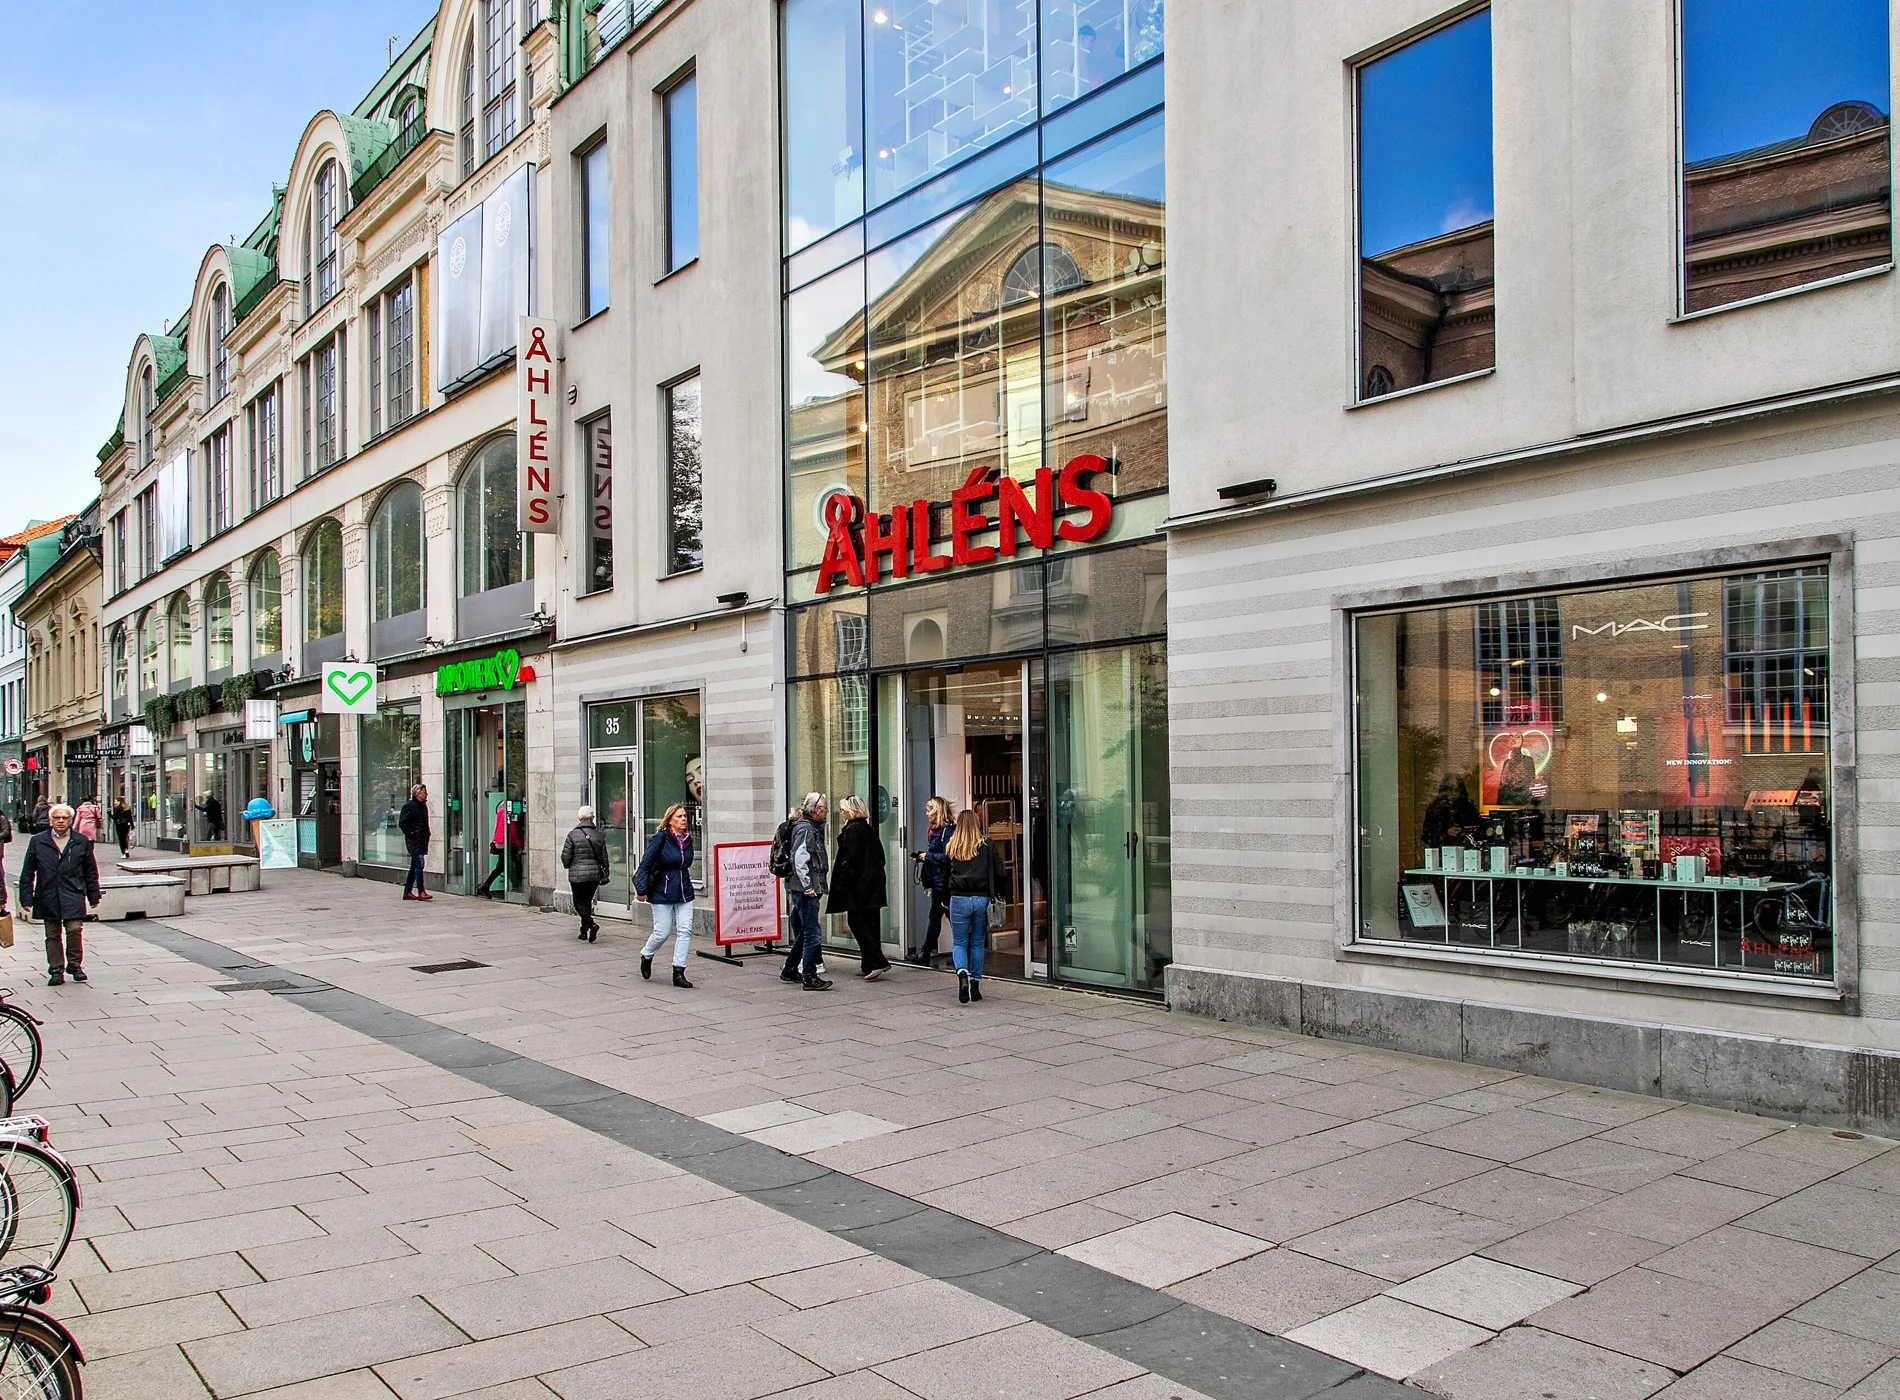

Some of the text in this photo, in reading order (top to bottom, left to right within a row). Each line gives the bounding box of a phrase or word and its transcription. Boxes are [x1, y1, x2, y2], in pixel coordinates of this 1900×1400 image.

[525, 326, 552, 524] ÅHLÉNS
[815, 454, 1112, 594] ÅHLÉNS
[436, 657, 500, 695] APOTEK
[605, 717, 620, 735] 35
[1684, 758, 1733, 766] INNOVATION!
